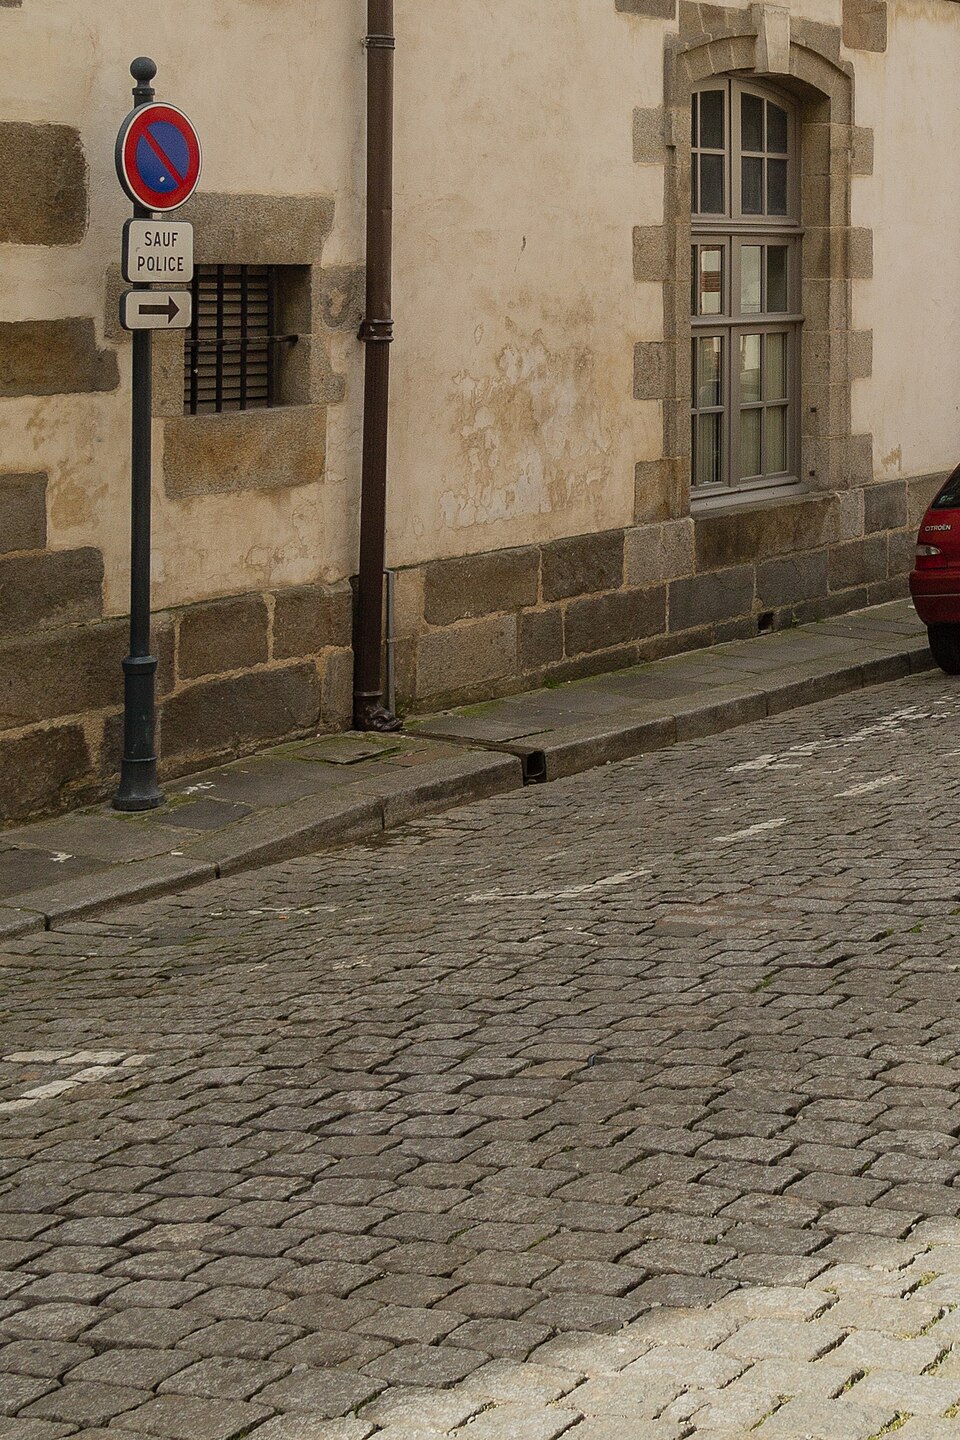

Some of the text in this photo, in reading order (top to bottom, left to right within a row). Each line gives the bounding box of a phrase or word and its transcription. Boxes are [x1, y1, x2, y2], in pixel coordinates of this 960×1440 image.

[144, 231, 178, 247] SAUF
[137, 256, 184, 271] POLICE
[924, 523, 952, 532] CITROËN
